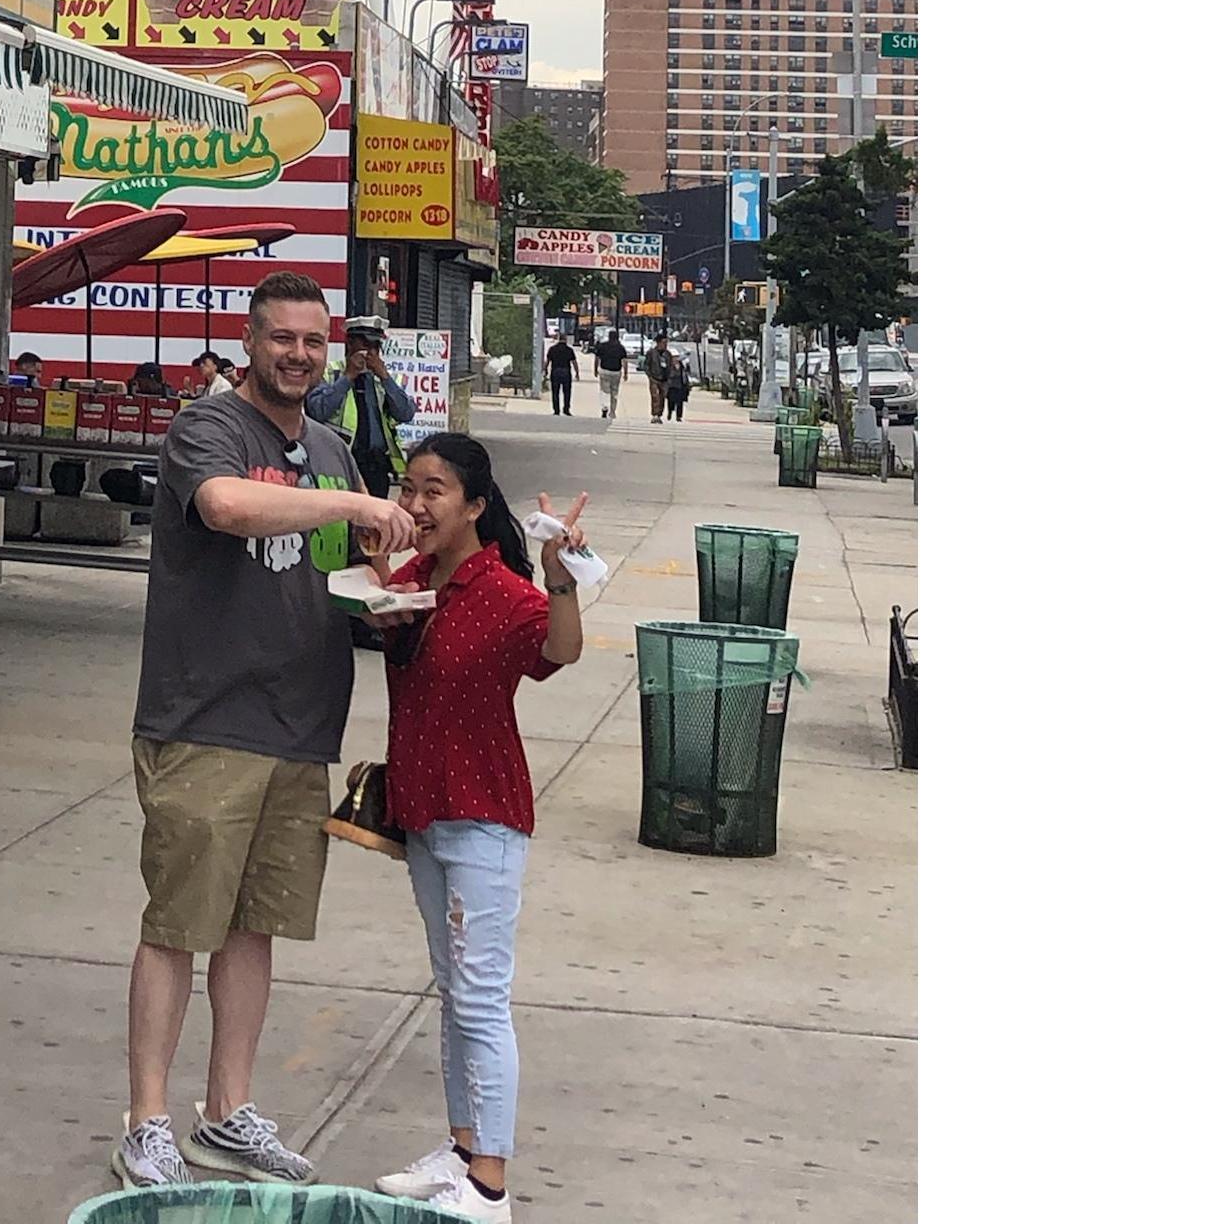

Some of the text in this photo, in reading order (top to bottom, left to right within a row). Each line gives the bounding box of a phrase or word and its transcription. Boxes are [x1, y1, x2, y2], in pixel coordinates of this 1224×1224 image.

[57, 0, 114, 17] ANDY
[365, 137, 450, 151] COTTON CANDY
[364, 160, 445, 174] CANDY APPLES
[111, 176, 168, 195] FAMOUS
[363, 183, 423, 197] LOLLIPOPS
[360, 209, 412, 223] POPCORN
[537, 229, 591, 242] CANDY
[615, 233, 661, 245] ICE
[539, 241, 594, 254] APPLES
[615, 244, 660, 256] CREAM
[600, 255, 660, 269] POPCORN
[414, 375, 440, 393] ICE
[417, 397, 447, 414] EAM
